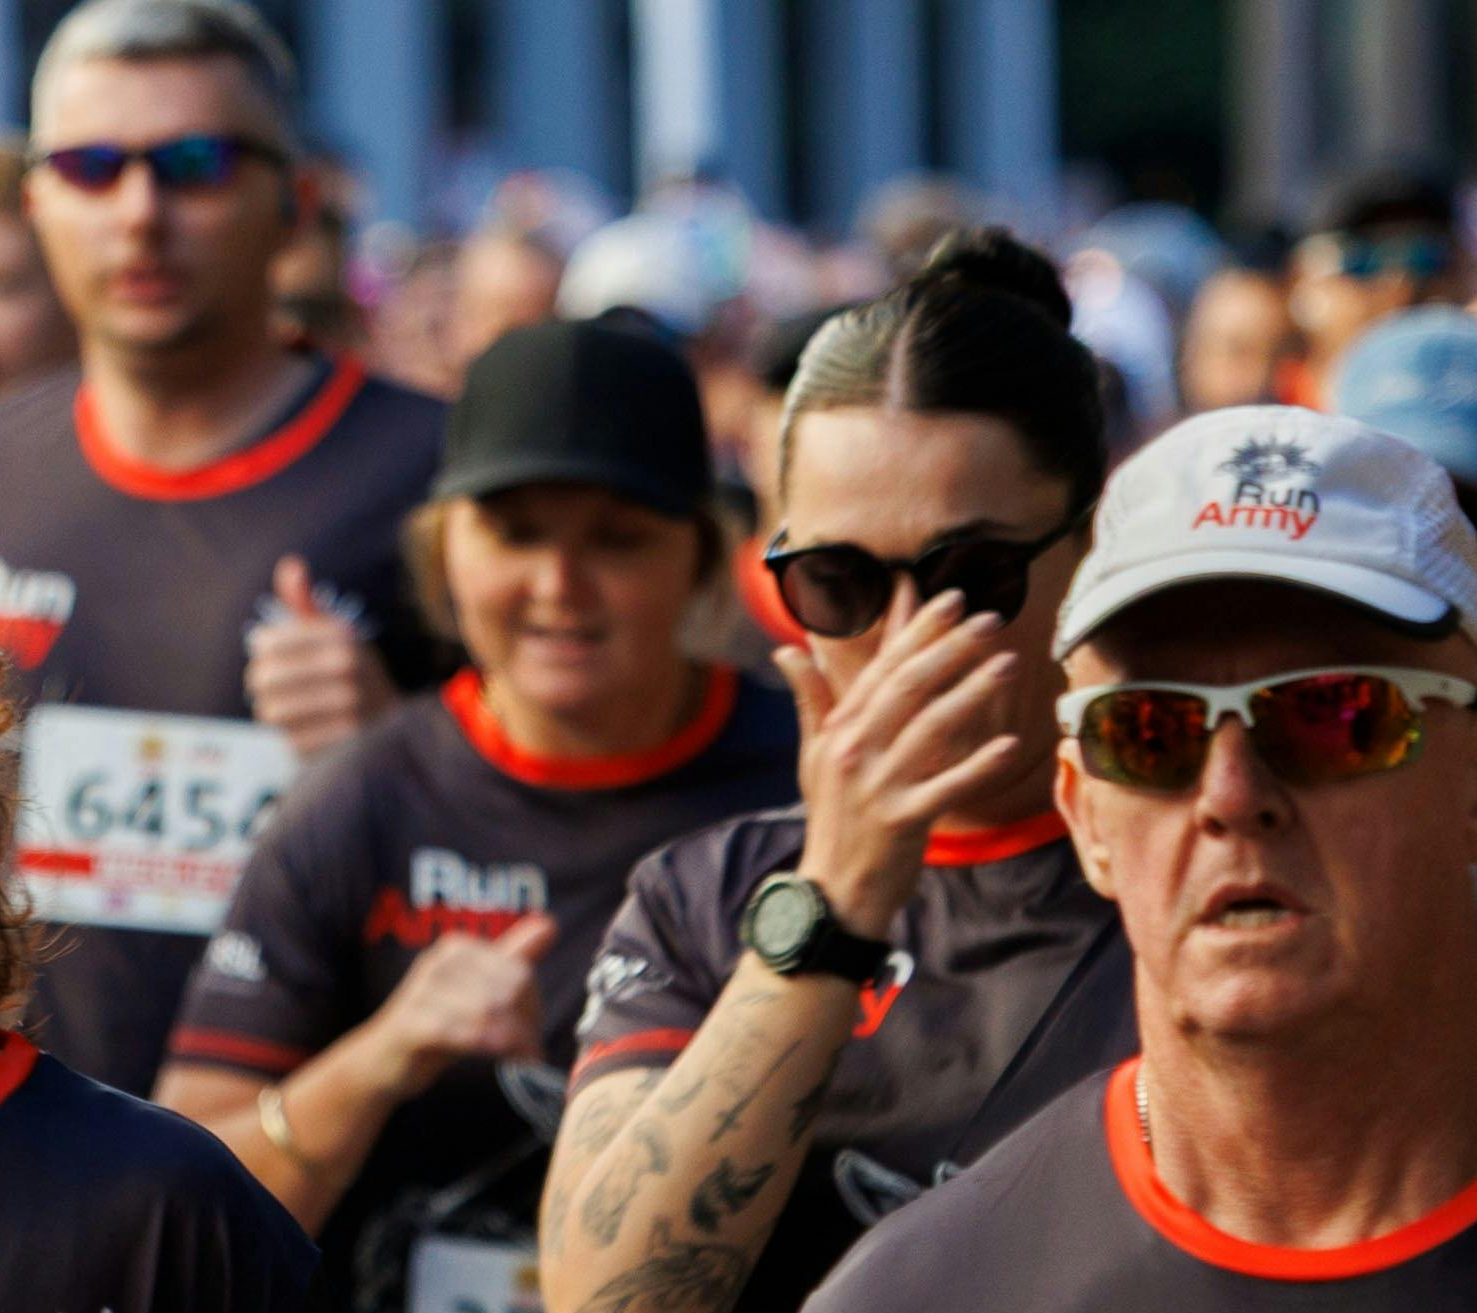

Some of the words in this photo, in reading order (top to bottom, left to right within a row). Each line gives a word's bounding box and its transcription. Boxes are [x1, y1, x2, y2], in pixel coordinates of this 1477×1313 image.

[1233, 481, 1320, 513] Run
[1191, 501, 1317, 541] Army
[410, 846, 547, 912] Run
